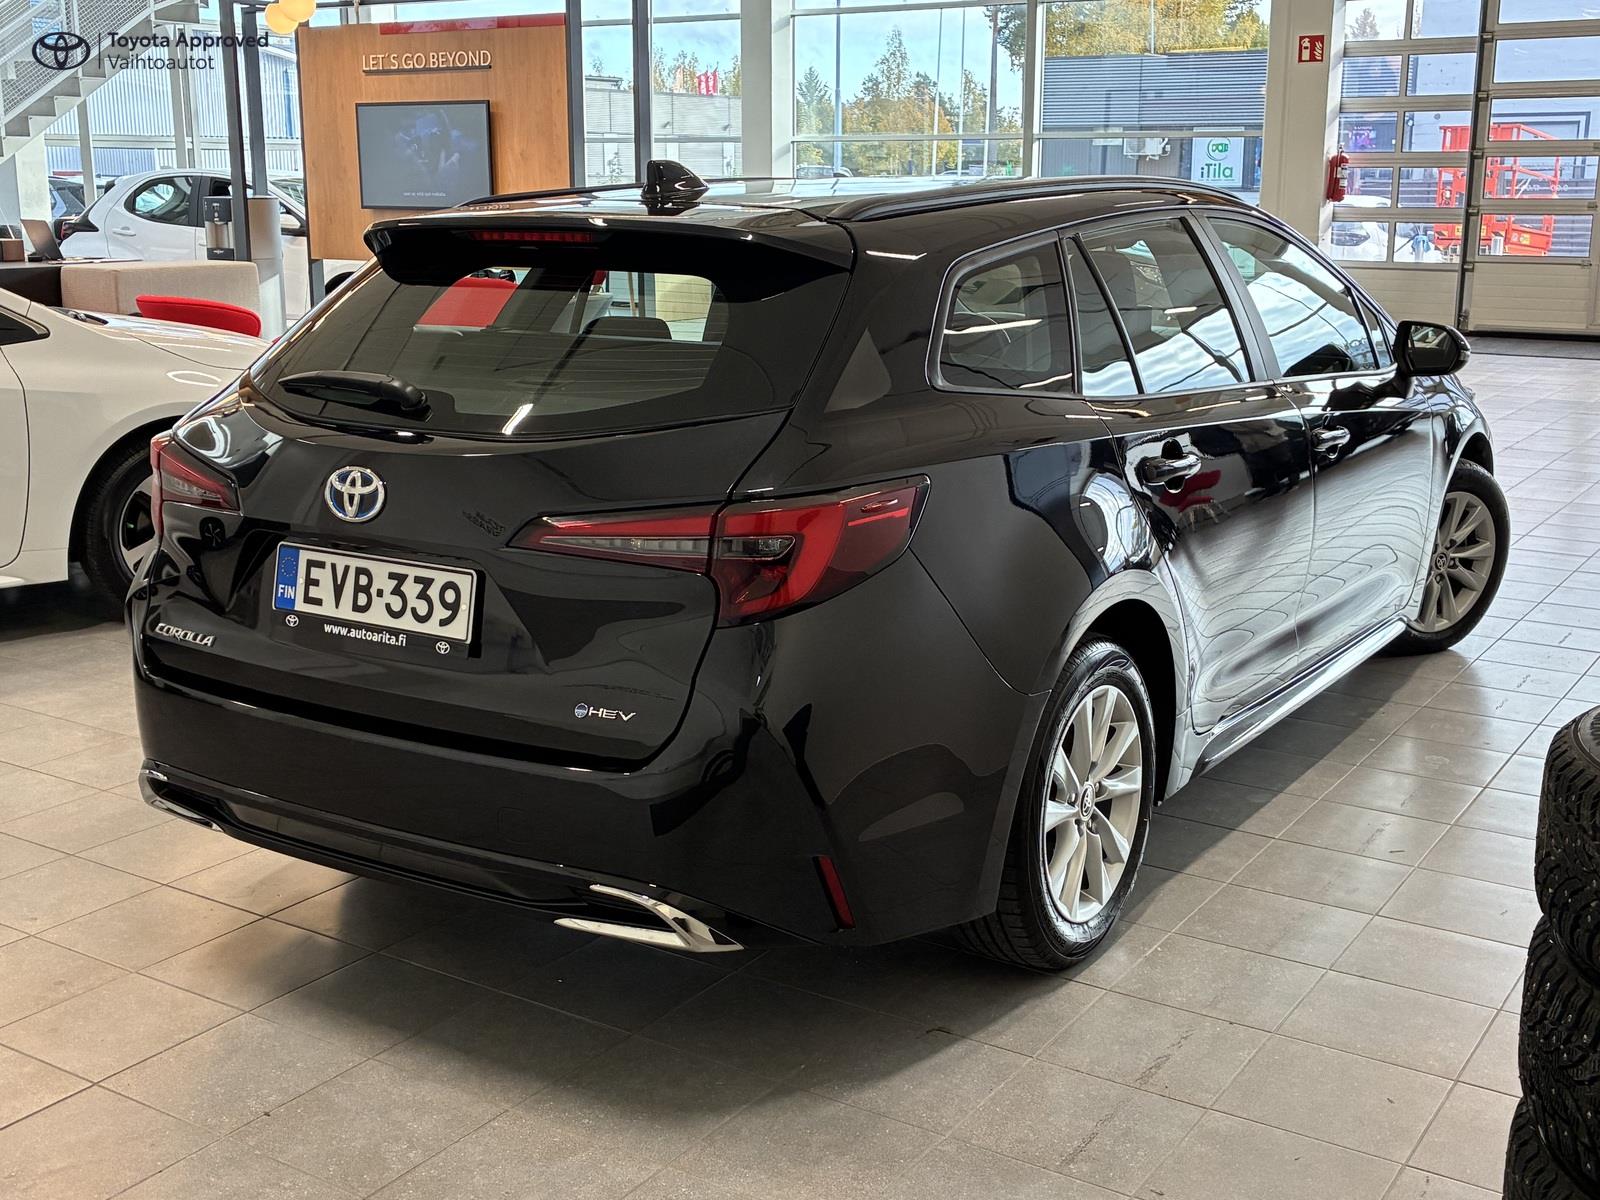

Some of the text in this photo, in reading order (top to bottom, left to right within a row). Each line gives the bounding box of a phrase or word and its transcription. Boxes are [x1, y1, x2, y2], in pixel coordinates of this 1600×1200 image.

[402, 52, 426, 69] GO
[429, 50, 492, 68] BEYOND
[1200, 162, 1234, 179] iTila
[277, 584, 296, 600] FIN
[302, 558, 462, 628] EVB-339
[154, 622, 216, 648] COROLLA
[323, 623, 407, 647] www.autoarita.fi
[588, 706, 637, 721] HEV
